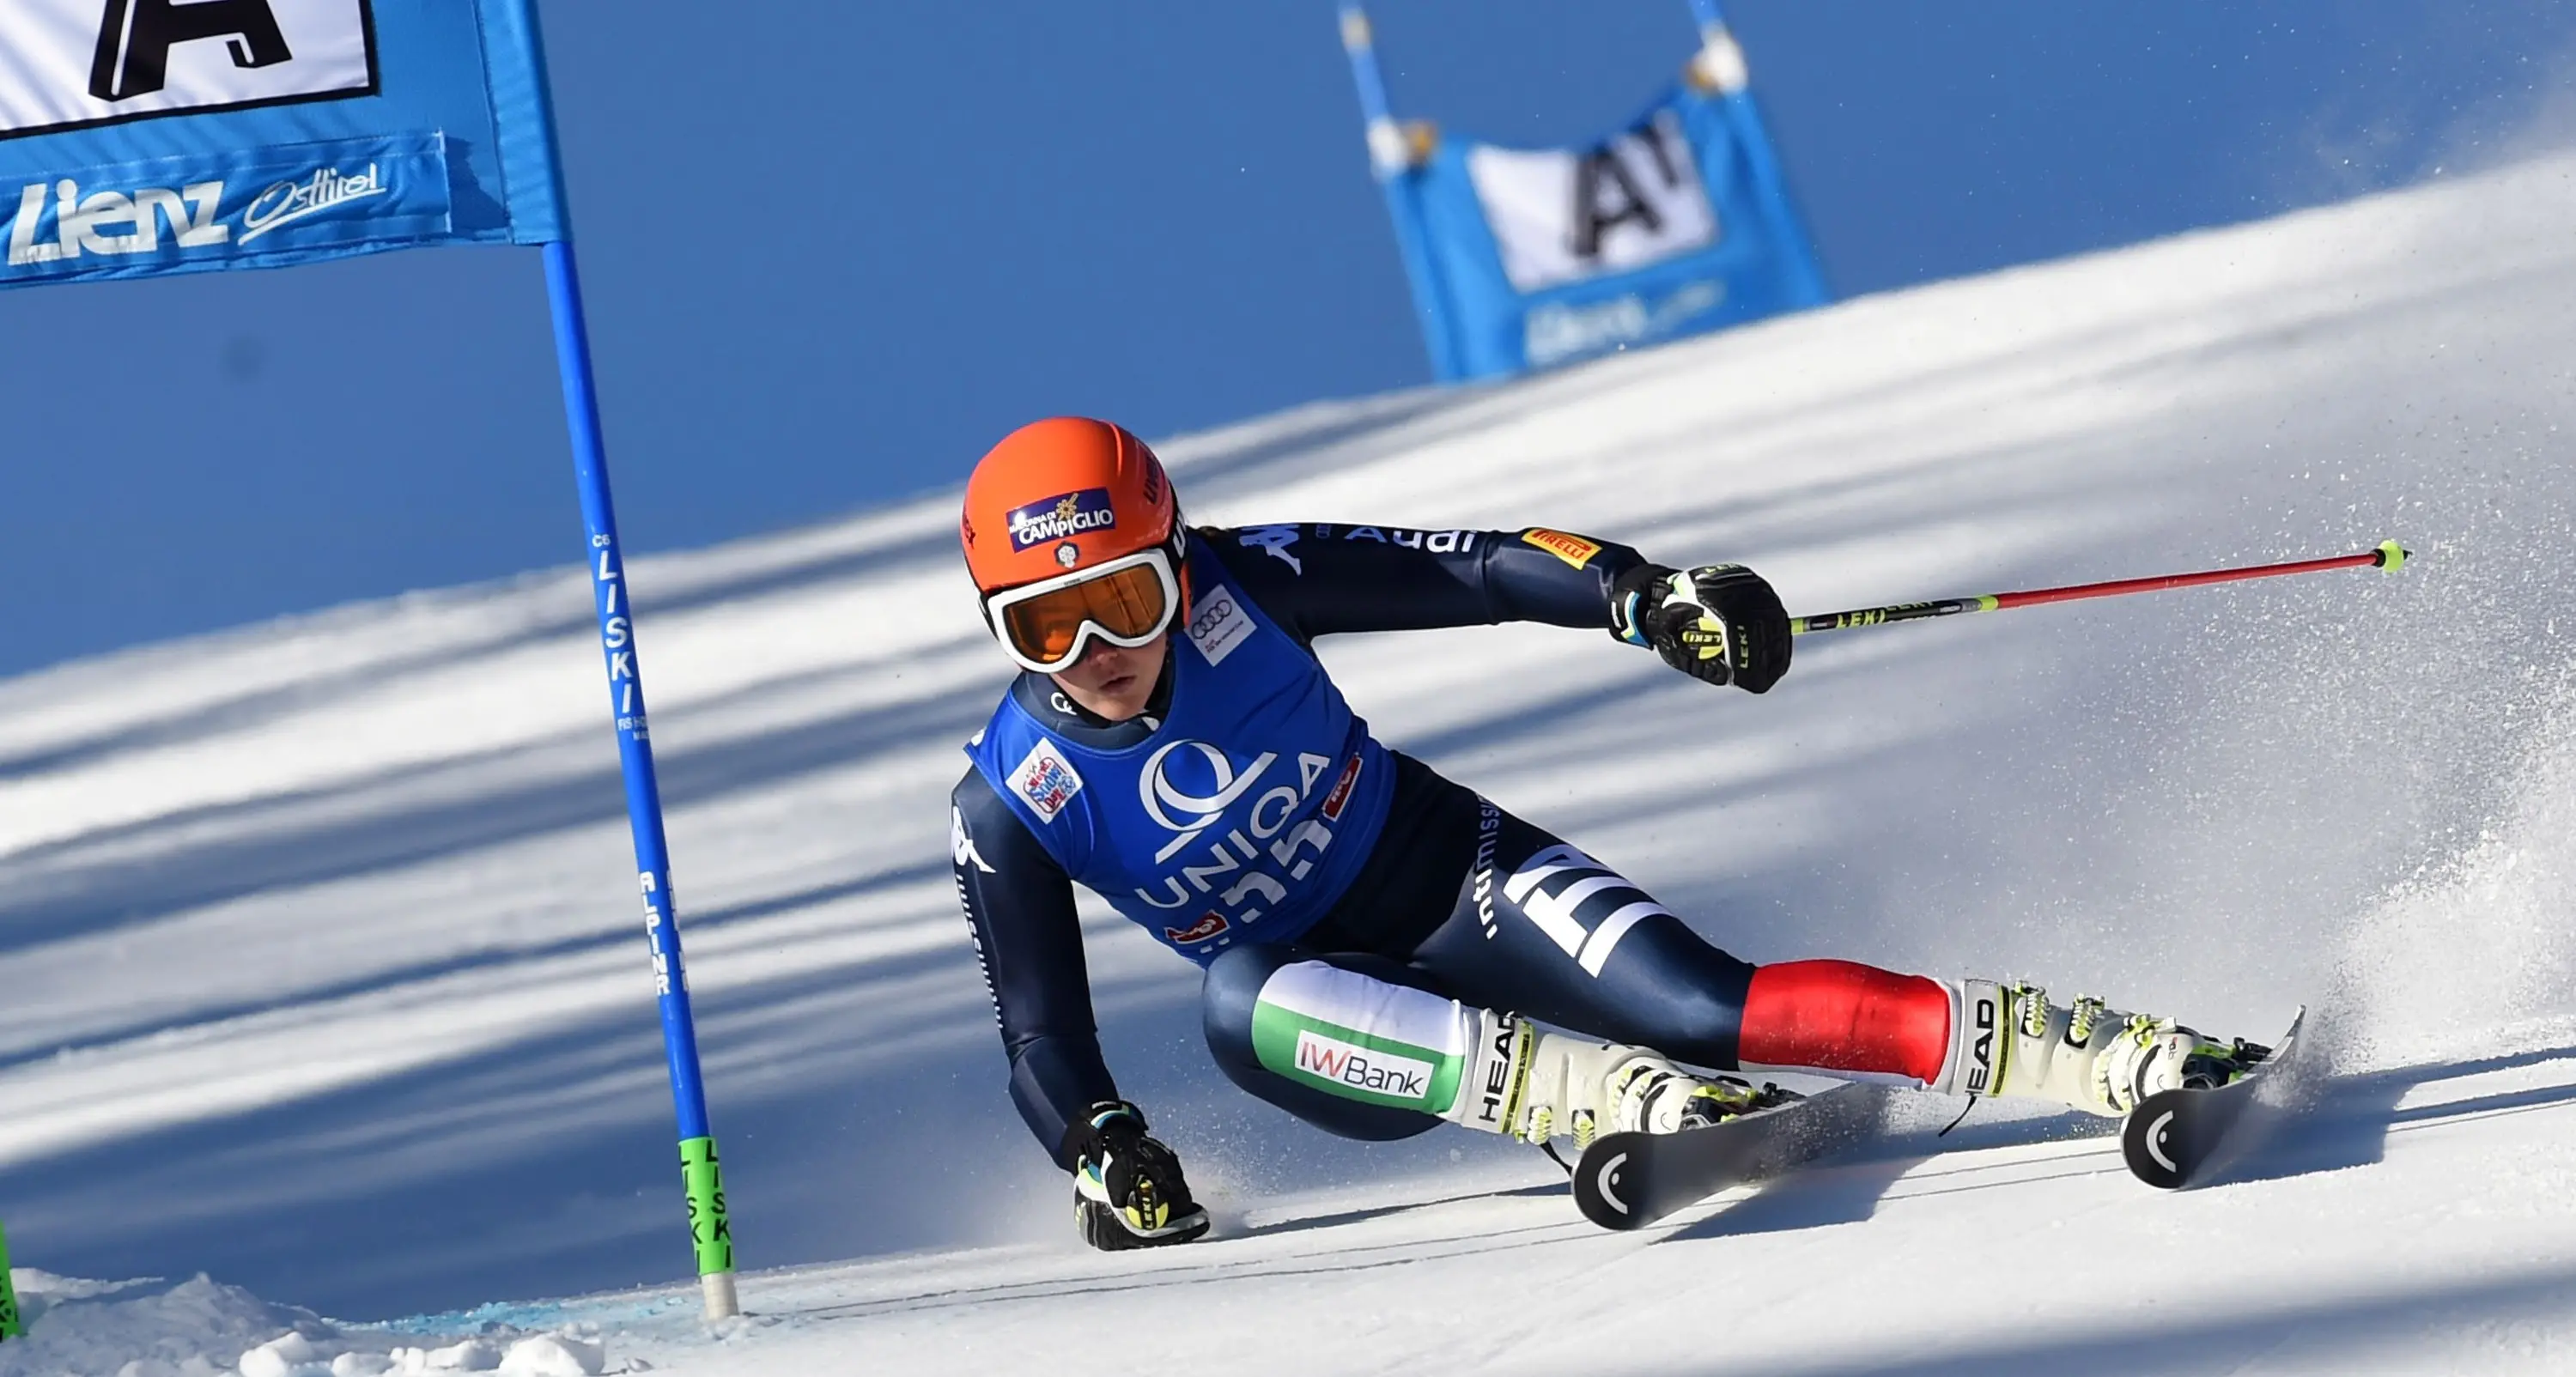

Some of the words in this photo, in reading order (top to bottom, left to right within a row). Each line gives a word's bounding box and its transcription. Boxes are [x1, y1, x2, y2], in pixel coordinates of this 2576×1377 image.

[9, 179, 229, 265] Lienz
[1018, 509, 1114, 544] CAMPIGLIO
[1344, 526, 1478, 553] Audi
[598, 549, 633, 713] LISKI
[1836, 610, 1886, 629] LEKI
[1134, 752, 1330, 909] UNIQA
[1300, 1040, 1424, 1096] IWBank
[705, 1139, 732, 1268] LISKI
